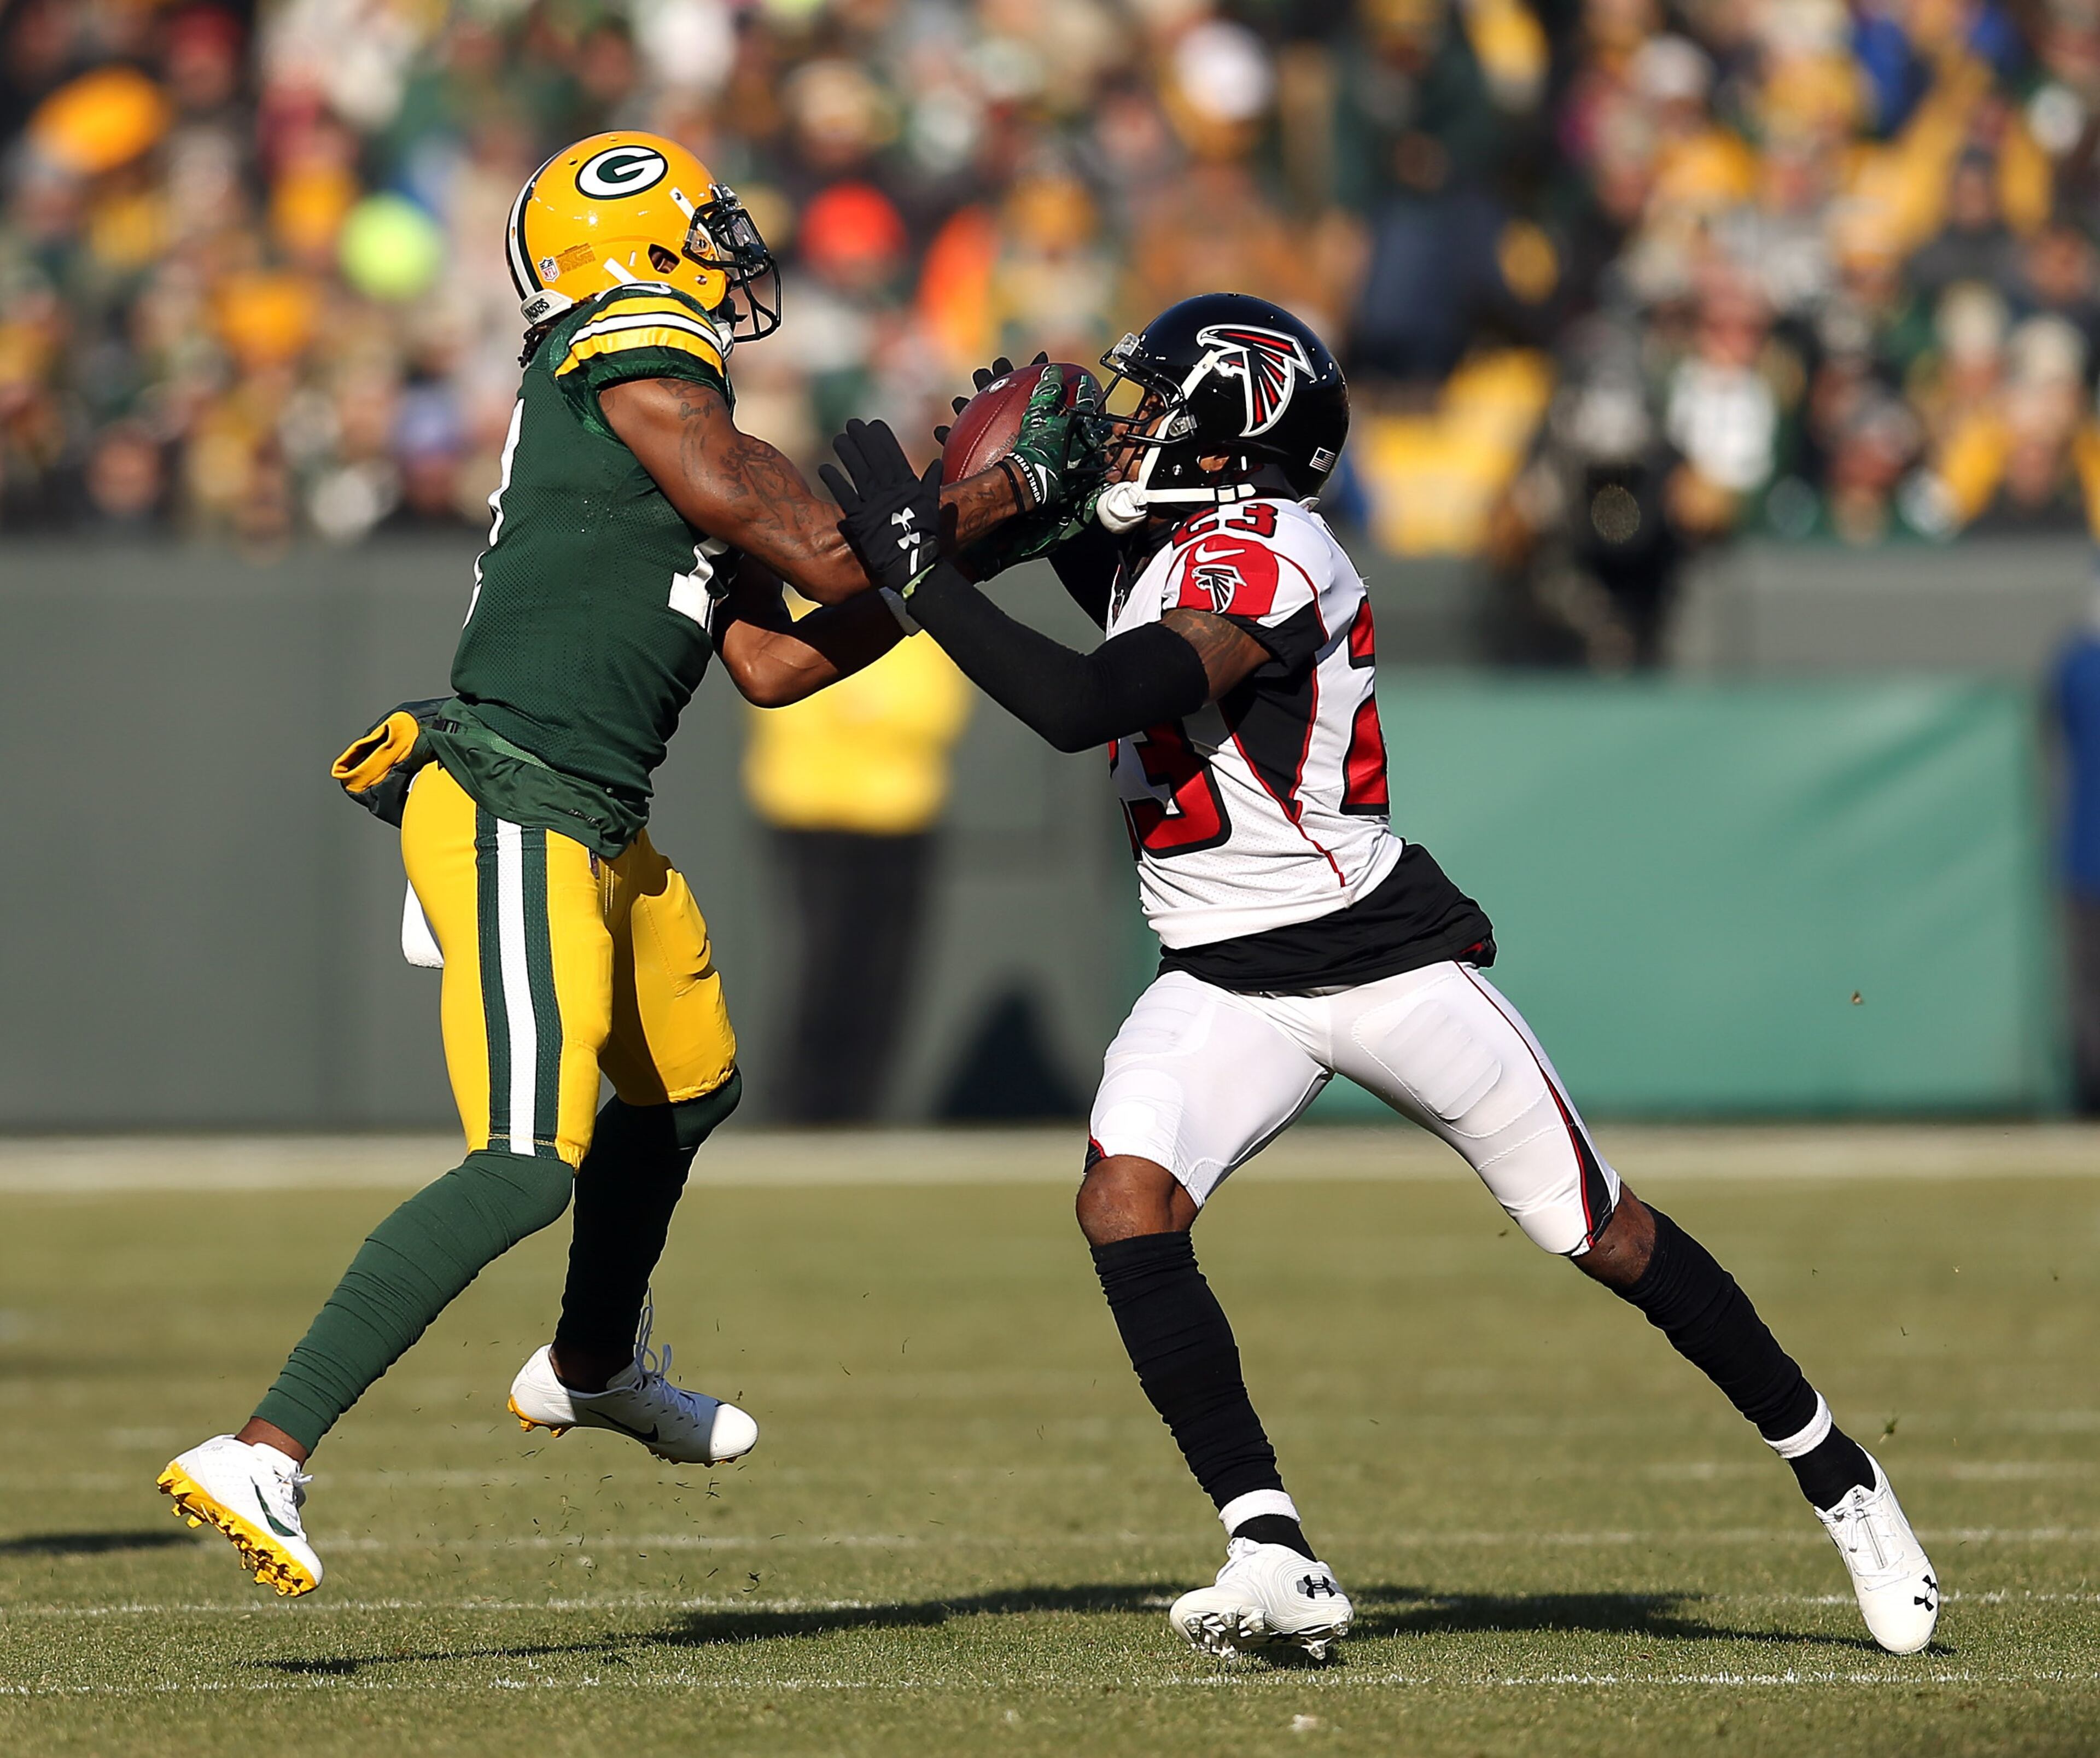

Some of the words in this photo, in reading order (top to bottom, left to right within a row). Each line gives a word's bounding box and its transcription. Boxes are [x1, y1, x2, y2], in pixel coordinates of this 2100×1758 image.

[575, 145, 668, 200] G
[1013, 453, 1030, 472] OVER
[1026, 471, 1042, 503] HUMBLE
[1172, 503, 1279, 551] 23
